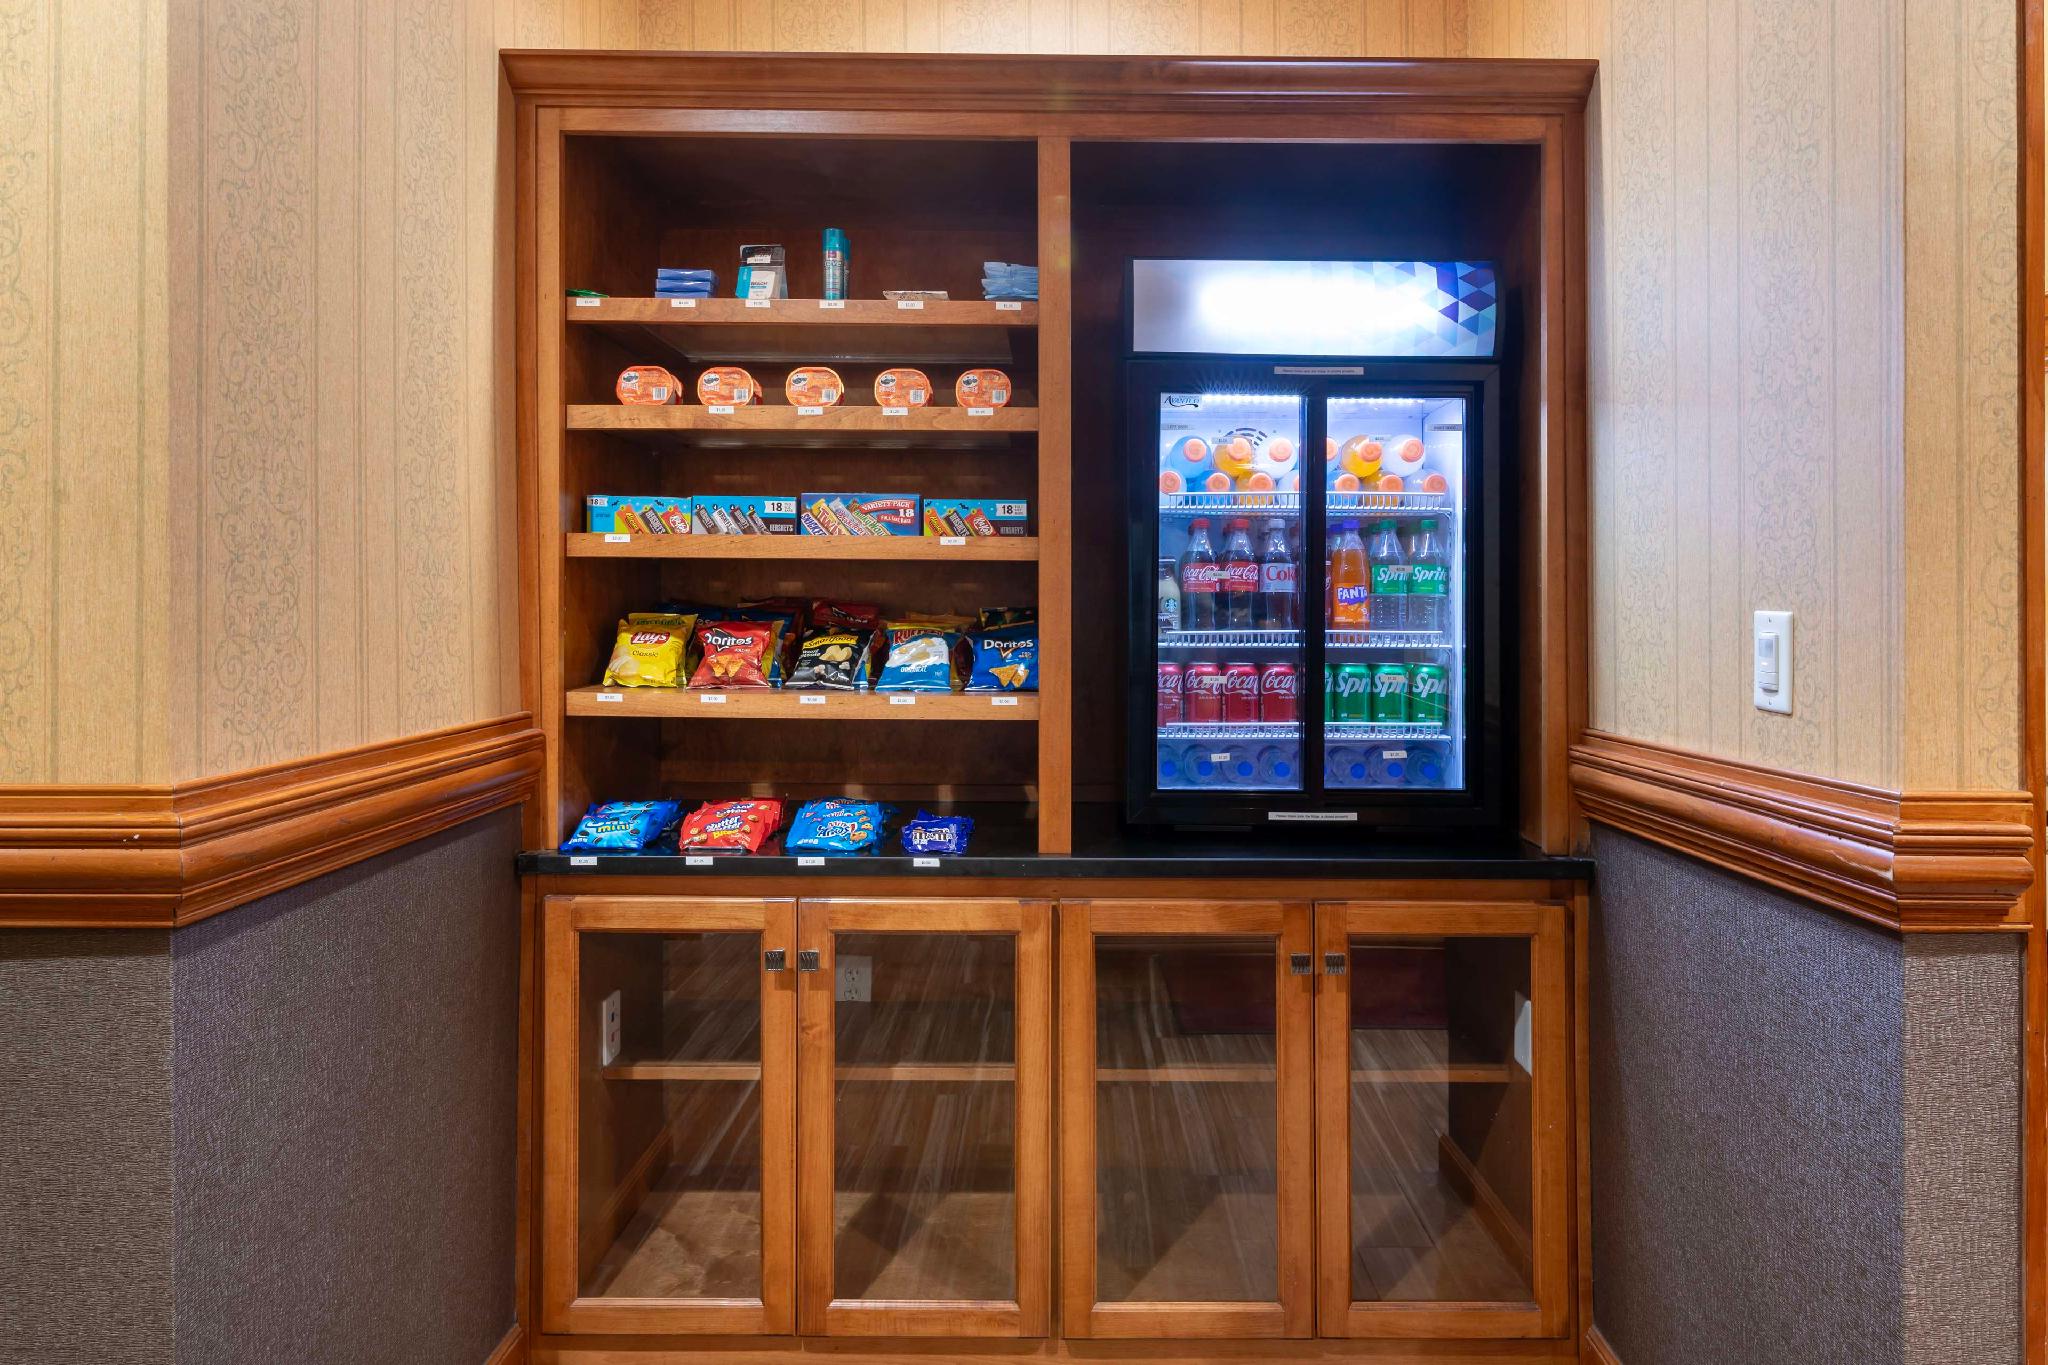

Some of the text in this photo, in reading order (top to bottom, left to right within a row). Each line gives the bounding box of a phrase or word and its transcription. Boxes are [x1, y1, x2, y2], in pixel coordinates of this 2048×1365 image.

[771, 503, 782, 511] 18
[862, 500, 911, 511] VARIETY PACK
[1002, 505, 1013, 514] 18
[899, 509, 914, 517] 18
[983, 639, 1034, 649] Doritos
